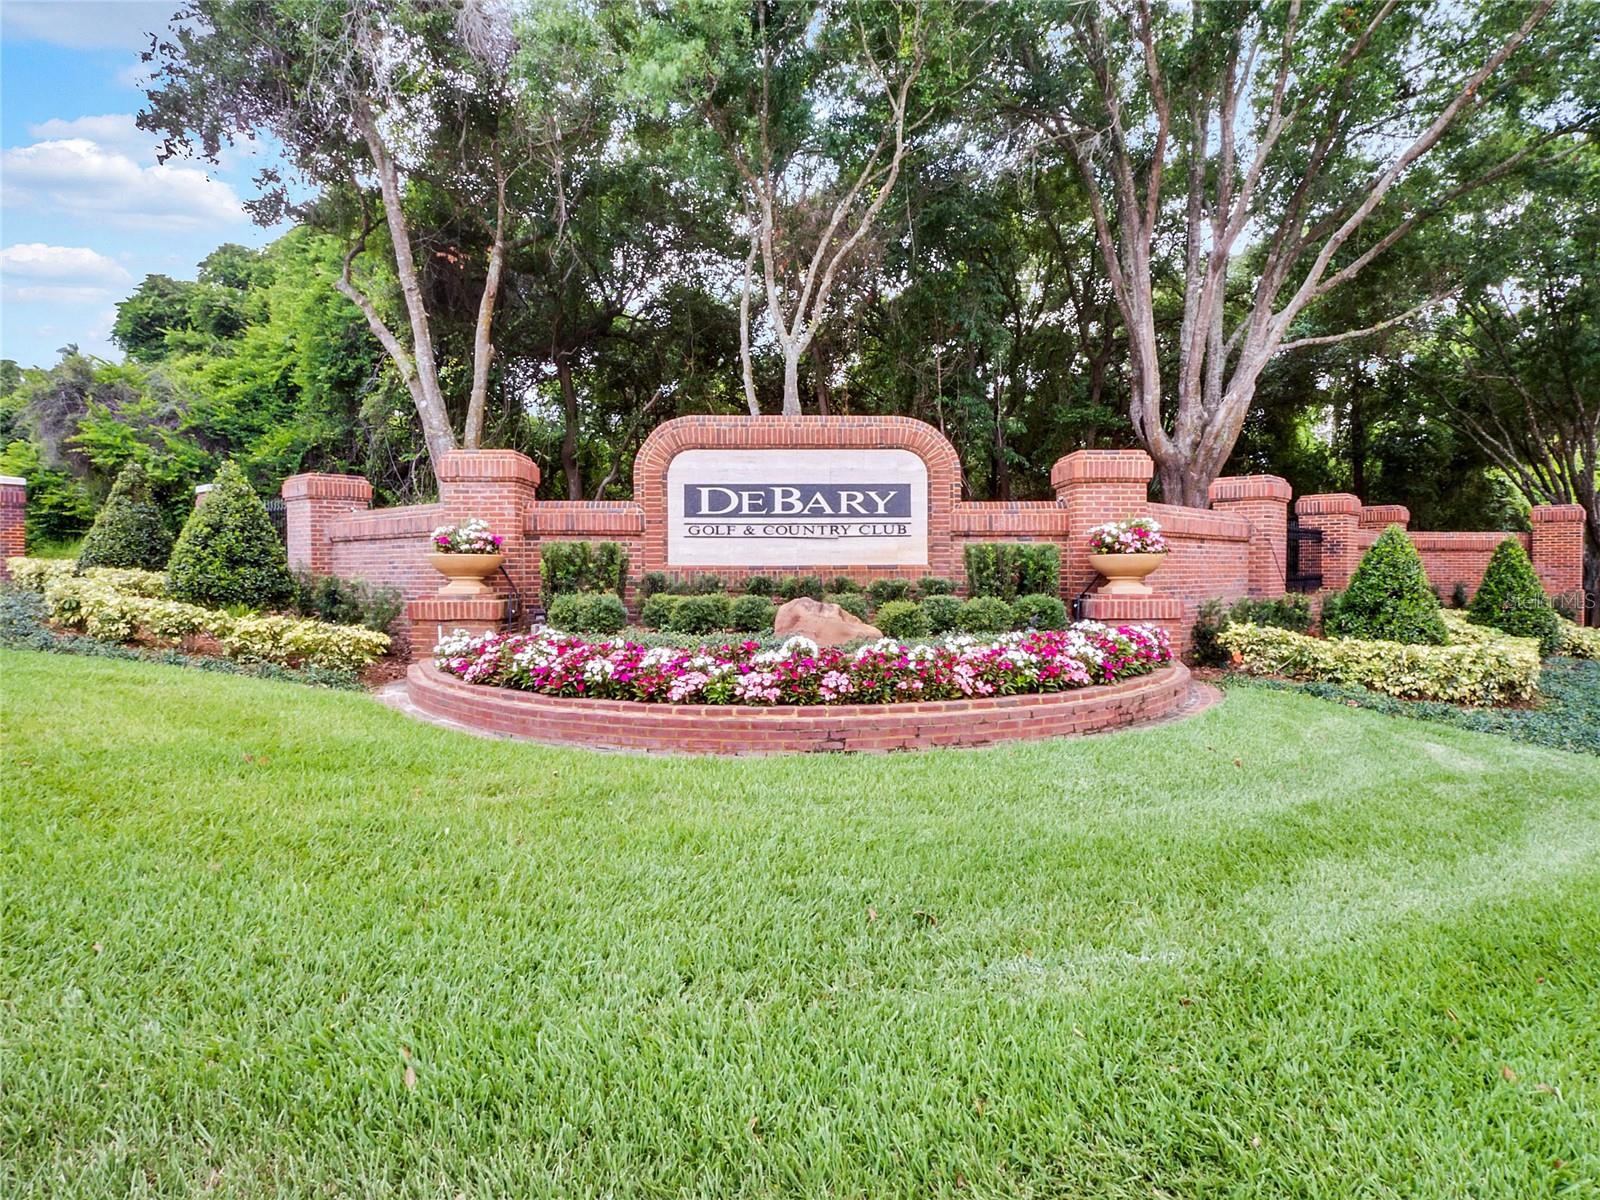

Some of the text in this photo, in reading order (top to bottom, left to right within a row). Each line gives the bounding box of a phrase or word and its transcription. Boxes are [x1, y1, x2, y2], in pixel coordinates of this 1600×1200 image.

[688, 524, 907, 536] GOLF & COUNTRY CLUB
